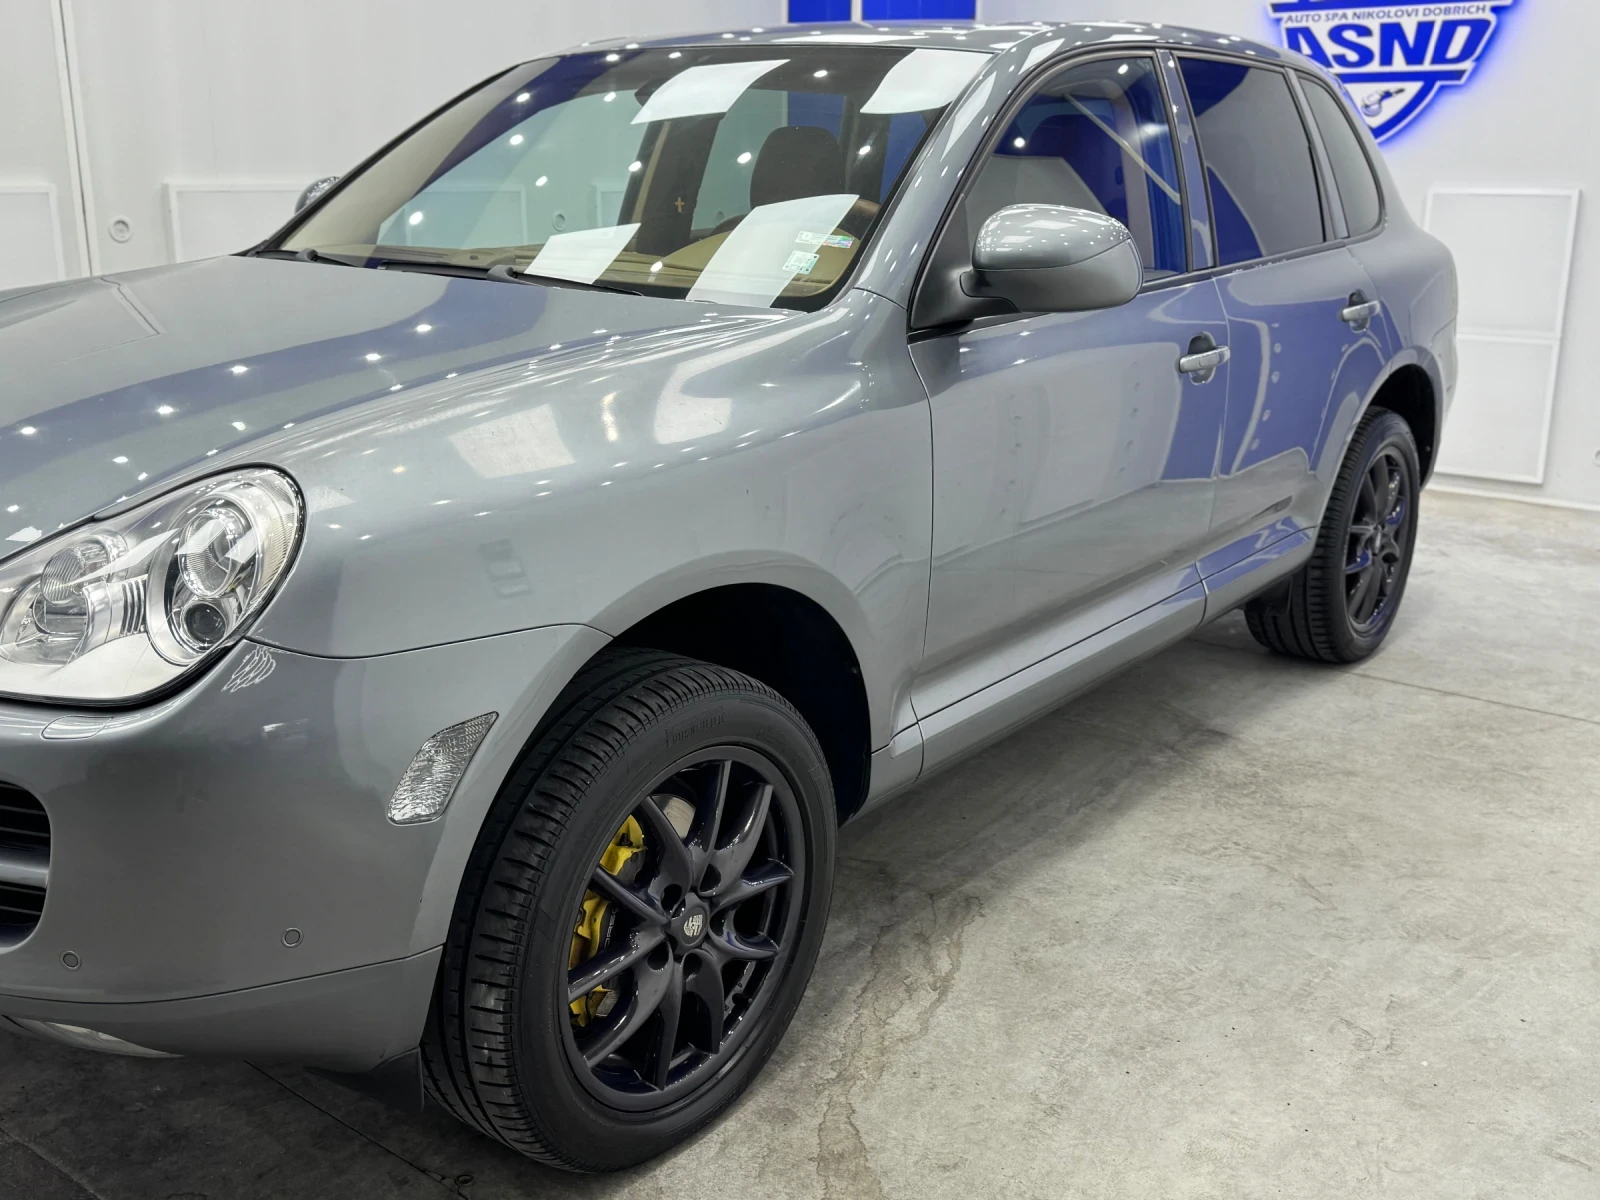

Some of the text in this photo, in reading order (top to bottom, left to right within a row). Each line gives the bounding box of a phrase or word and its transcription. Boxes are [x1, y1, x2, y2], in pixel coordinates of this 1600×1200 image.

[1284, 4, 1486, 24] AUTO SPA NIKOLOVI DOBRICH
[1285, 18, 1493, 69] ASND
